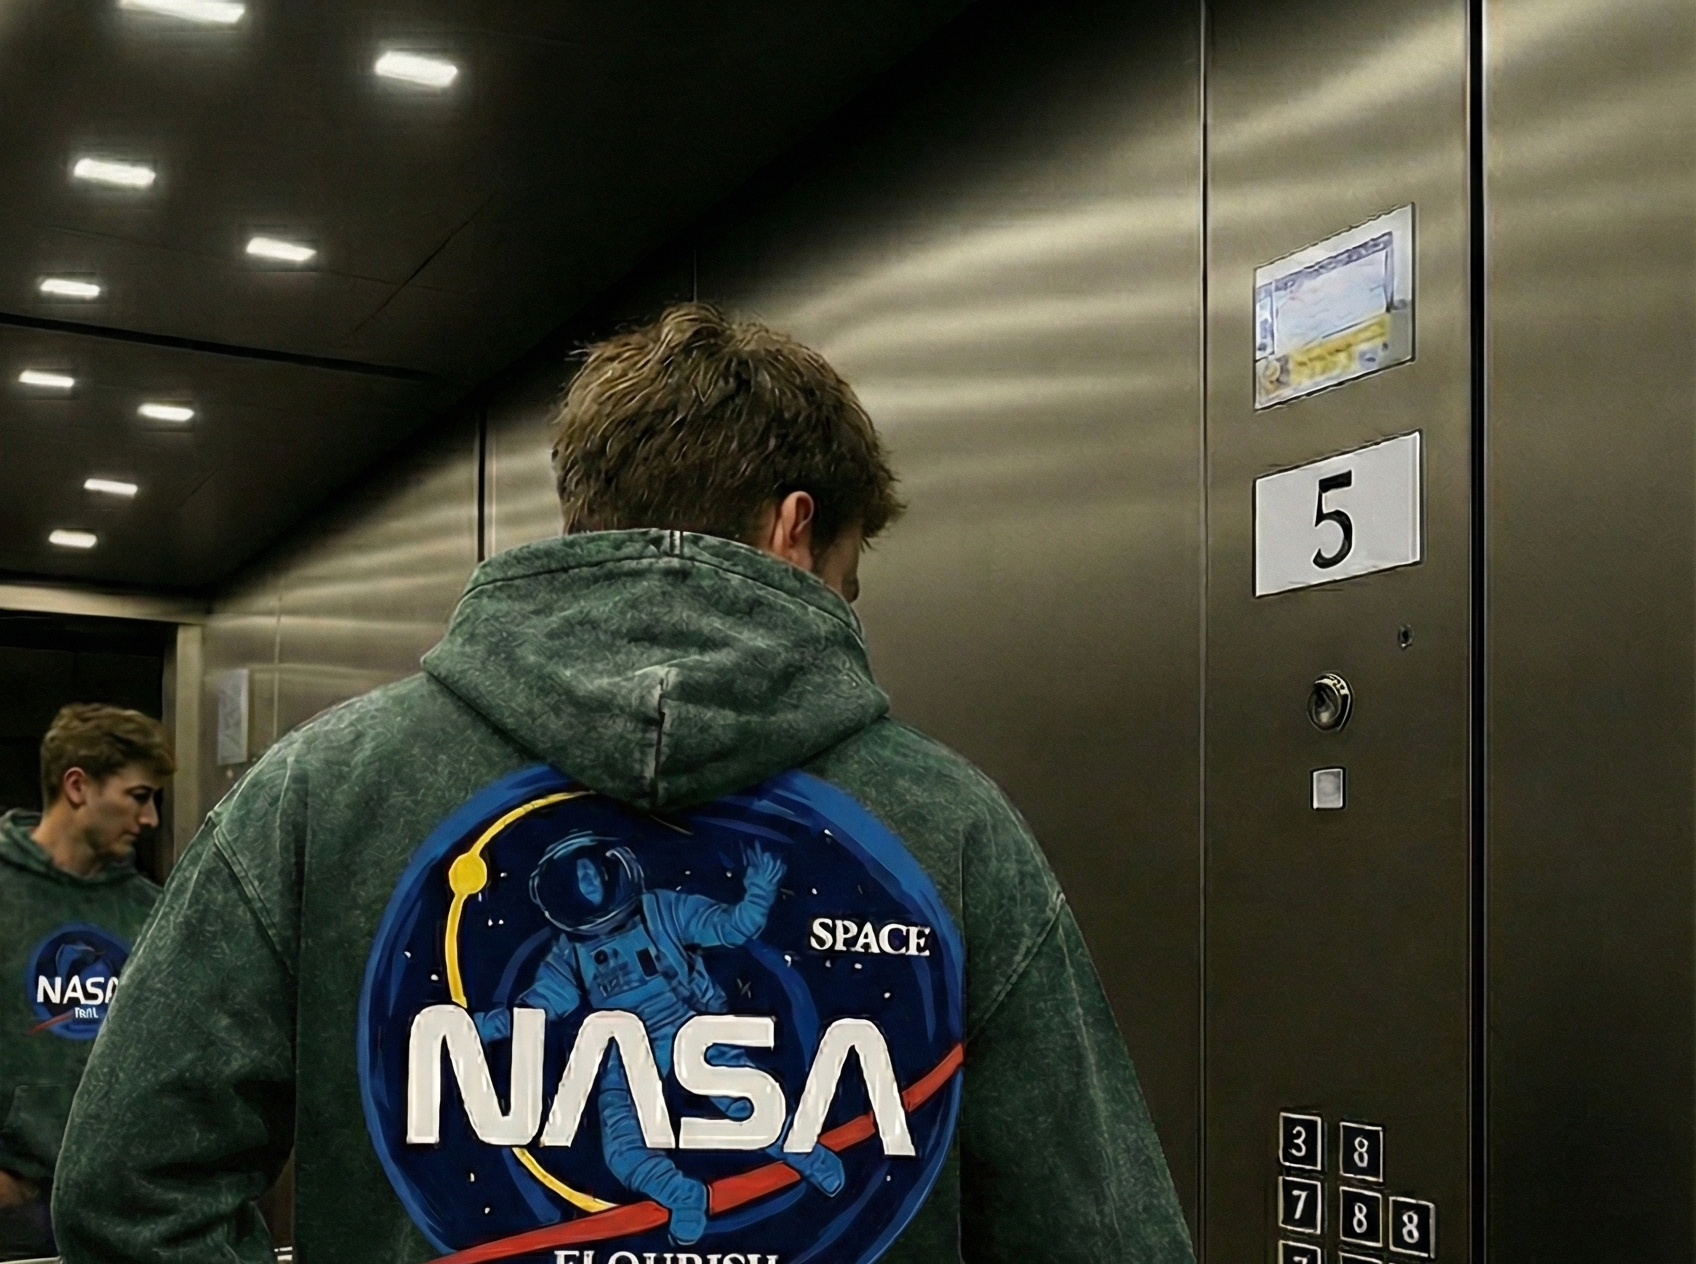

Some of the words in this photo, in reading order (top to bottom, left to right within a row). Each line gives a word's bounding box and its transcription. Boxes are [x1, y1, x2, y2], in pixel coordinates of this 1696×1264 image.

[1312, 469, 1354, 570] 5
[810, 917, 931, 957] SPACE
[405, 1004, 917, 1157] NASA
[1353, 1135, 1369, 1168] 8
[1291, 1189, 1309, 1220] 7
[1352, 1202, 1367, 1234] 8
[1401, 1210, 1419, 1244] 8
